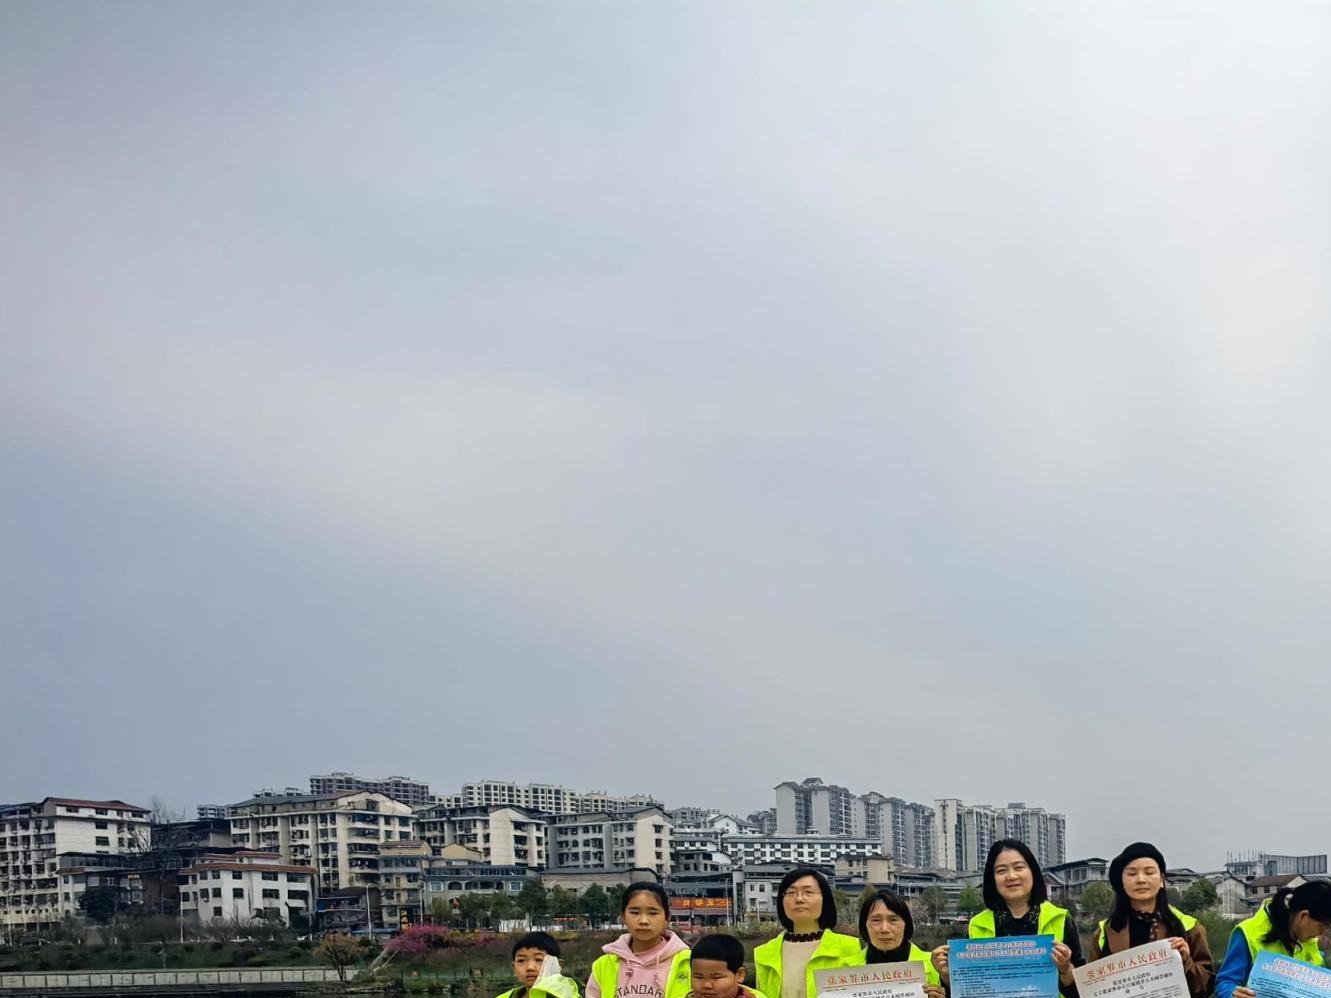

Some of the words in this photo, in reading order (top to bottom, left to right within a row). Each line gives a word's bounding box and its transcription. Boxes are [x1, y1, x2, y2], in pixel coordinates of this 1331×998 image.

[1087, 947, 1168, 979] 张家界市人民政府
[826, 968, 913, 986] 张家界市人民政府
